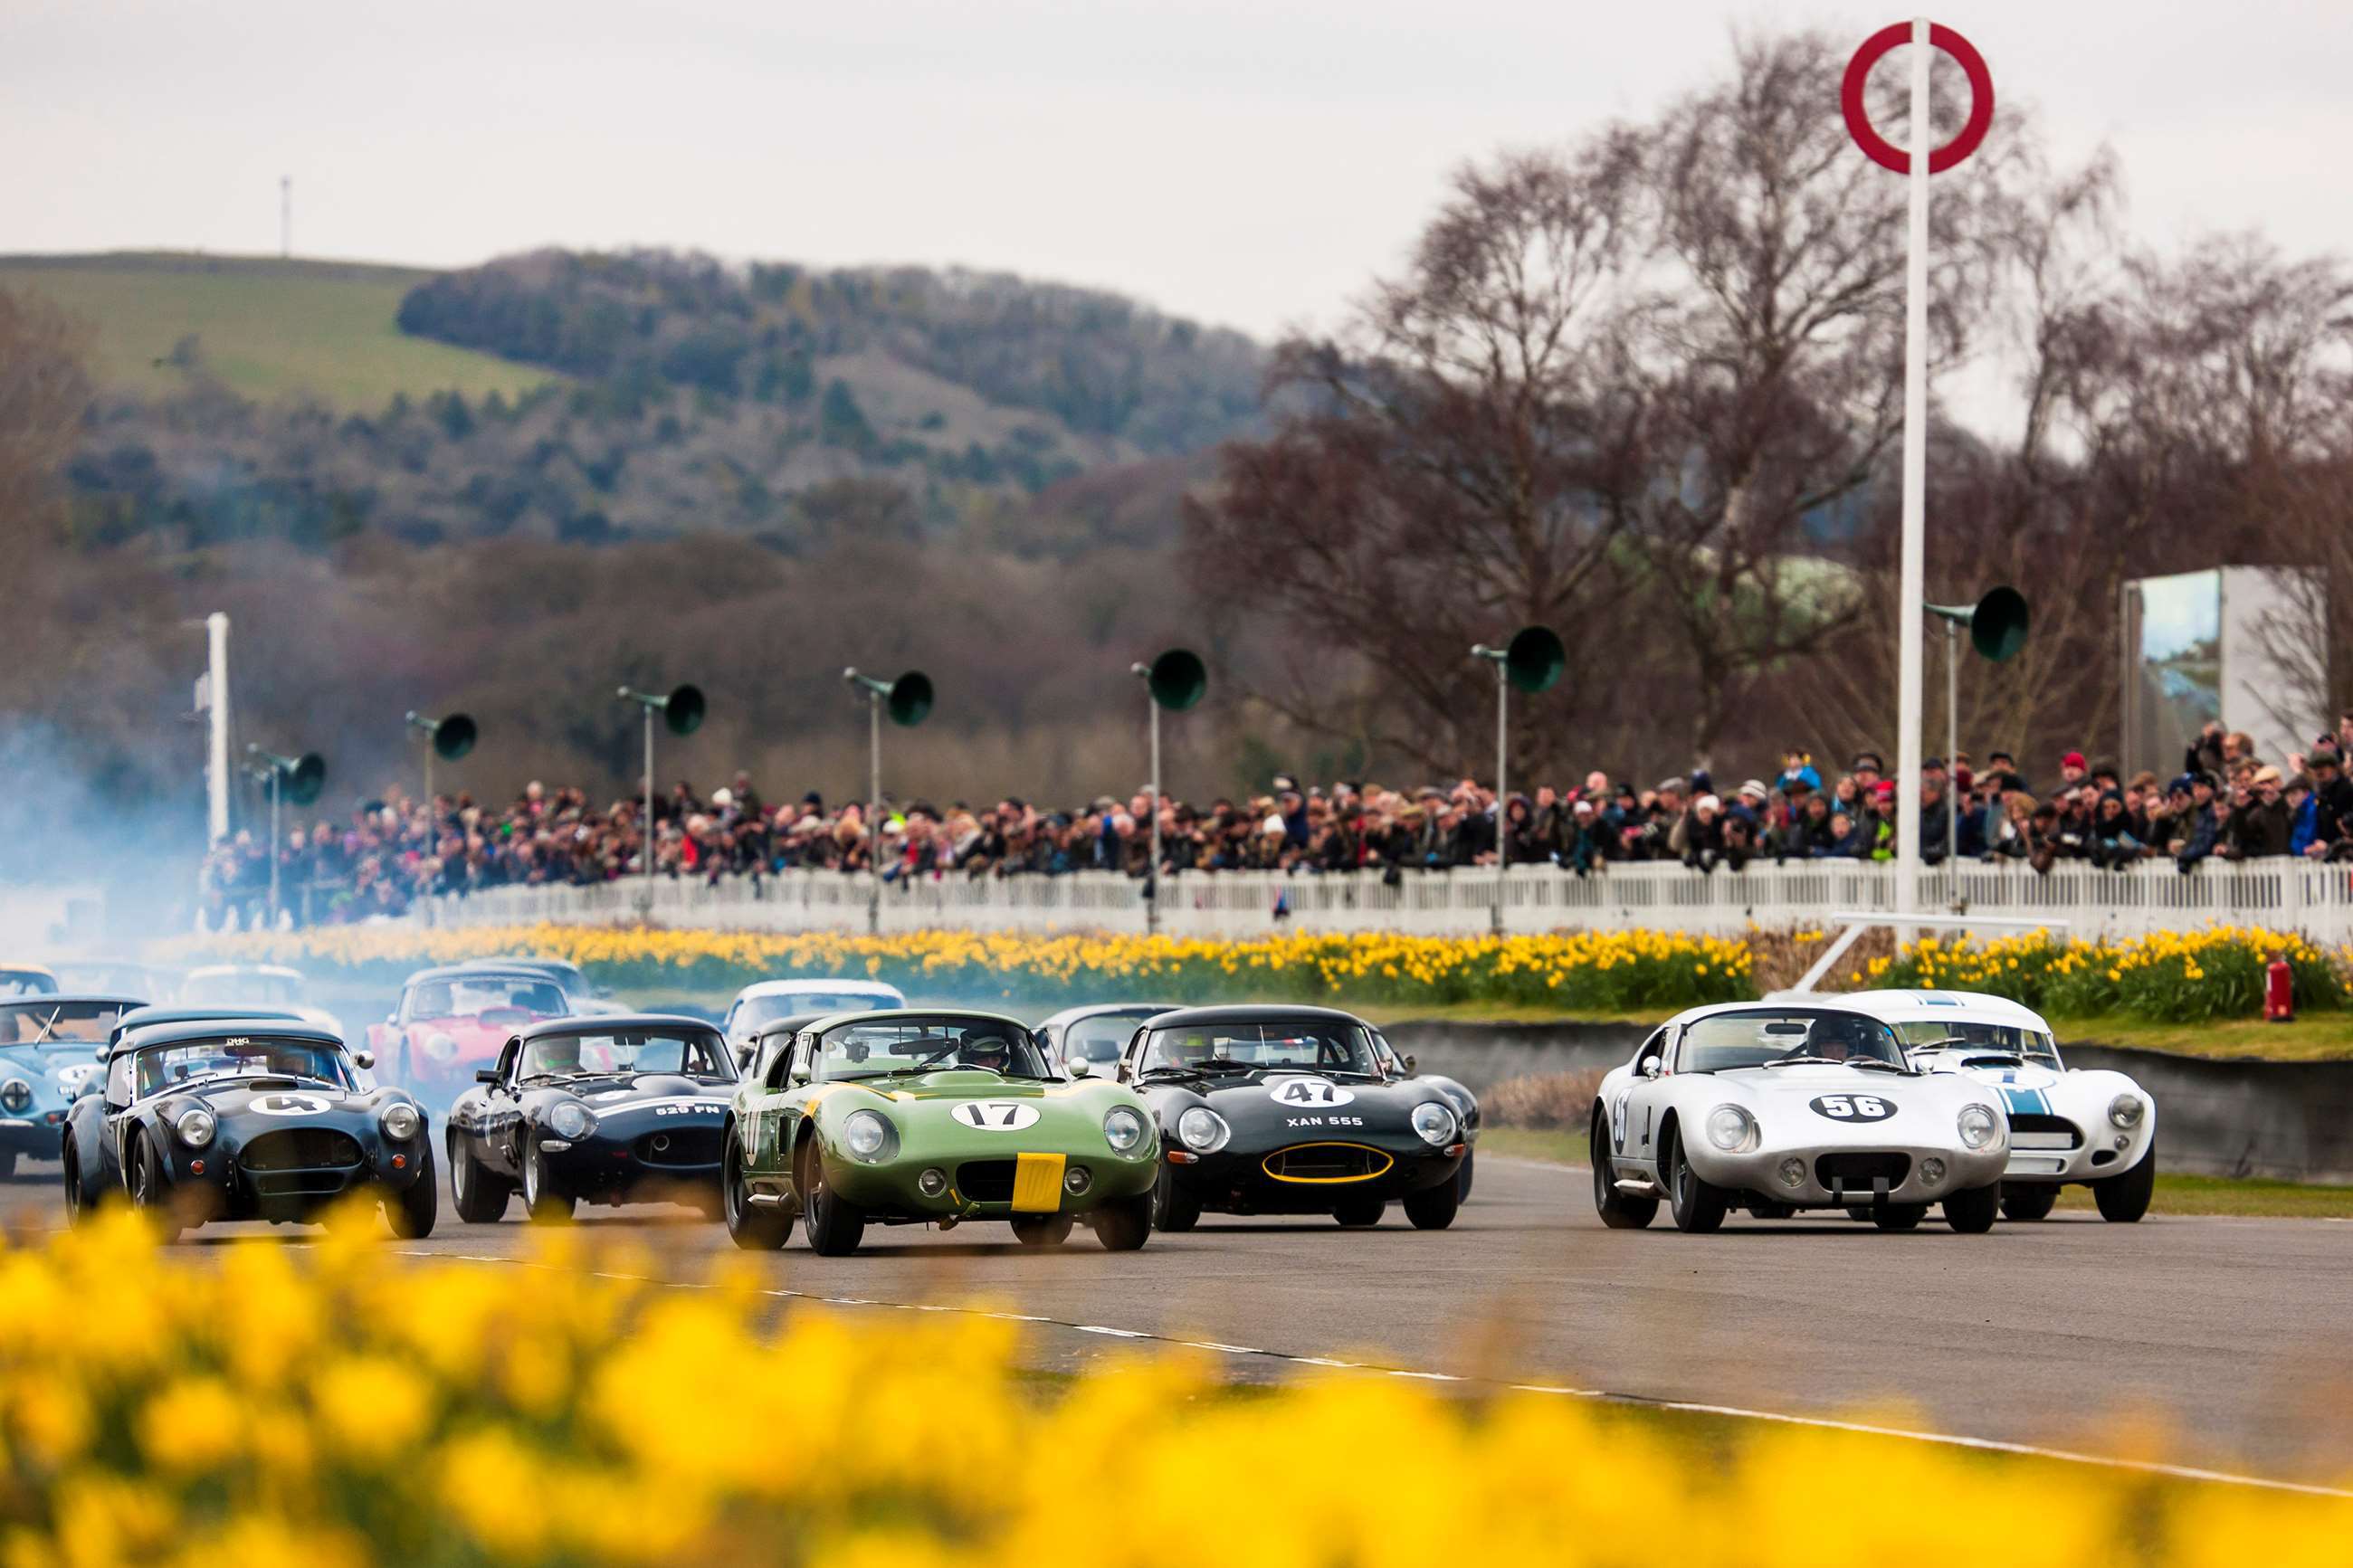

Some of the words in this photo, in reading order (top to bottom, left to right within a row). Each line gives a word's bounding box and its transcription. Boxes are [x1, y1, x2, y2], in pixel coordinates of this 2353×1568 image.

[1284, 1083, 1336, 1102] 47
[266, 1096, 318, 1111] 4
[694, 1106, 720, 1115] FN
[1820, 1097, 1886, 1117] 56
[967, 1104, 1019, 1126] 17
[1286, 1117, 1323, 1127] XAN
[1329, 1117, 1364, 1126] 555
